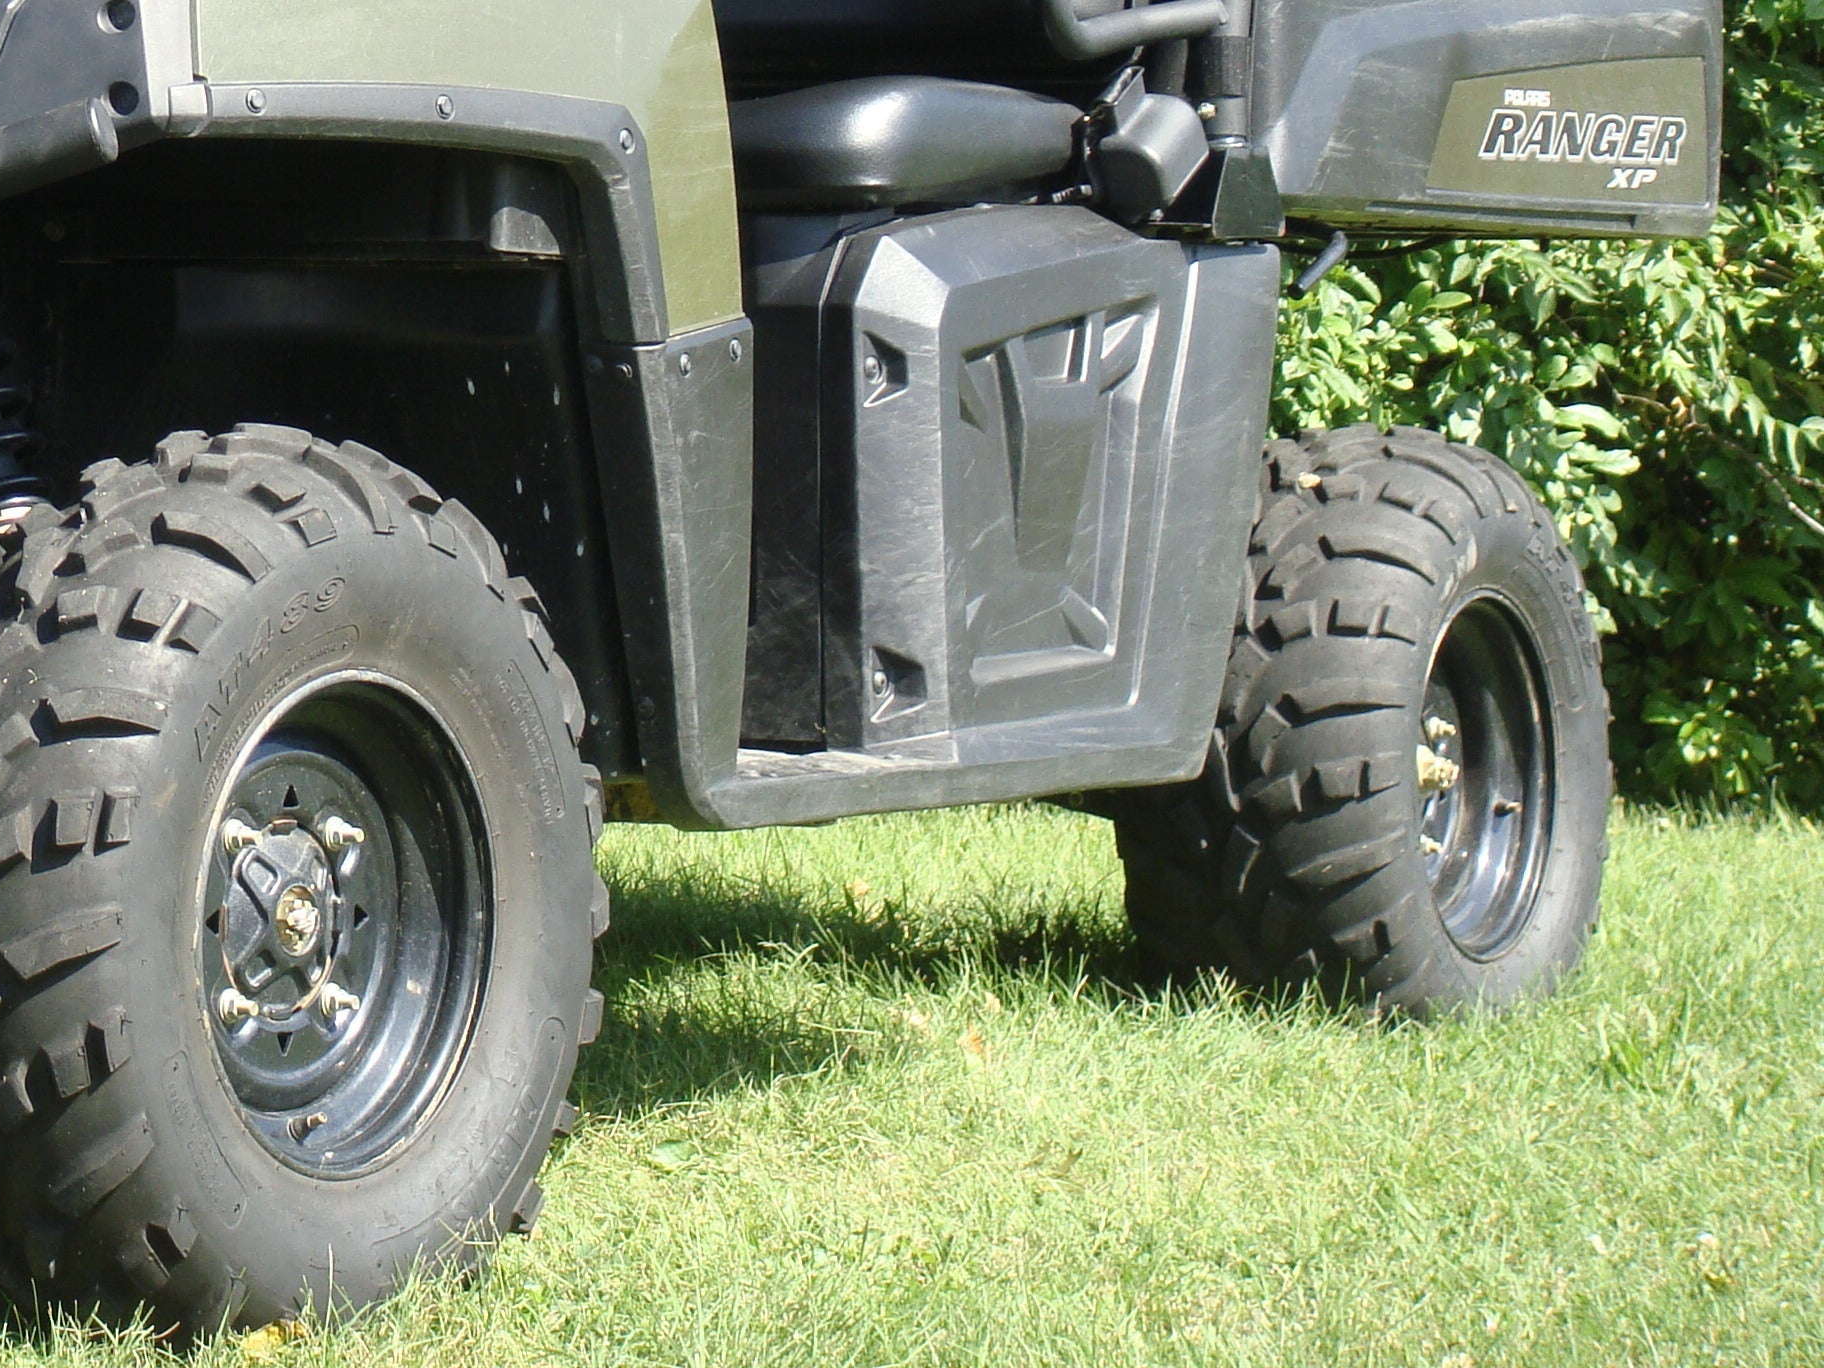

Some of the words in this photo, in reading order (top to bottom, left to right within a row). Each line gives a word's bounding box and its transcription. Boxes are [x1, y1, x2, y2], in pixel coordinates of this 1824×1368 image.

[1504, 88, 1551, 107] POLARIS
[1478, 108, 1687, 165] RANGER
[1606, 167, 1657, 189] XP
[193, 575, 347, 763] AT489
